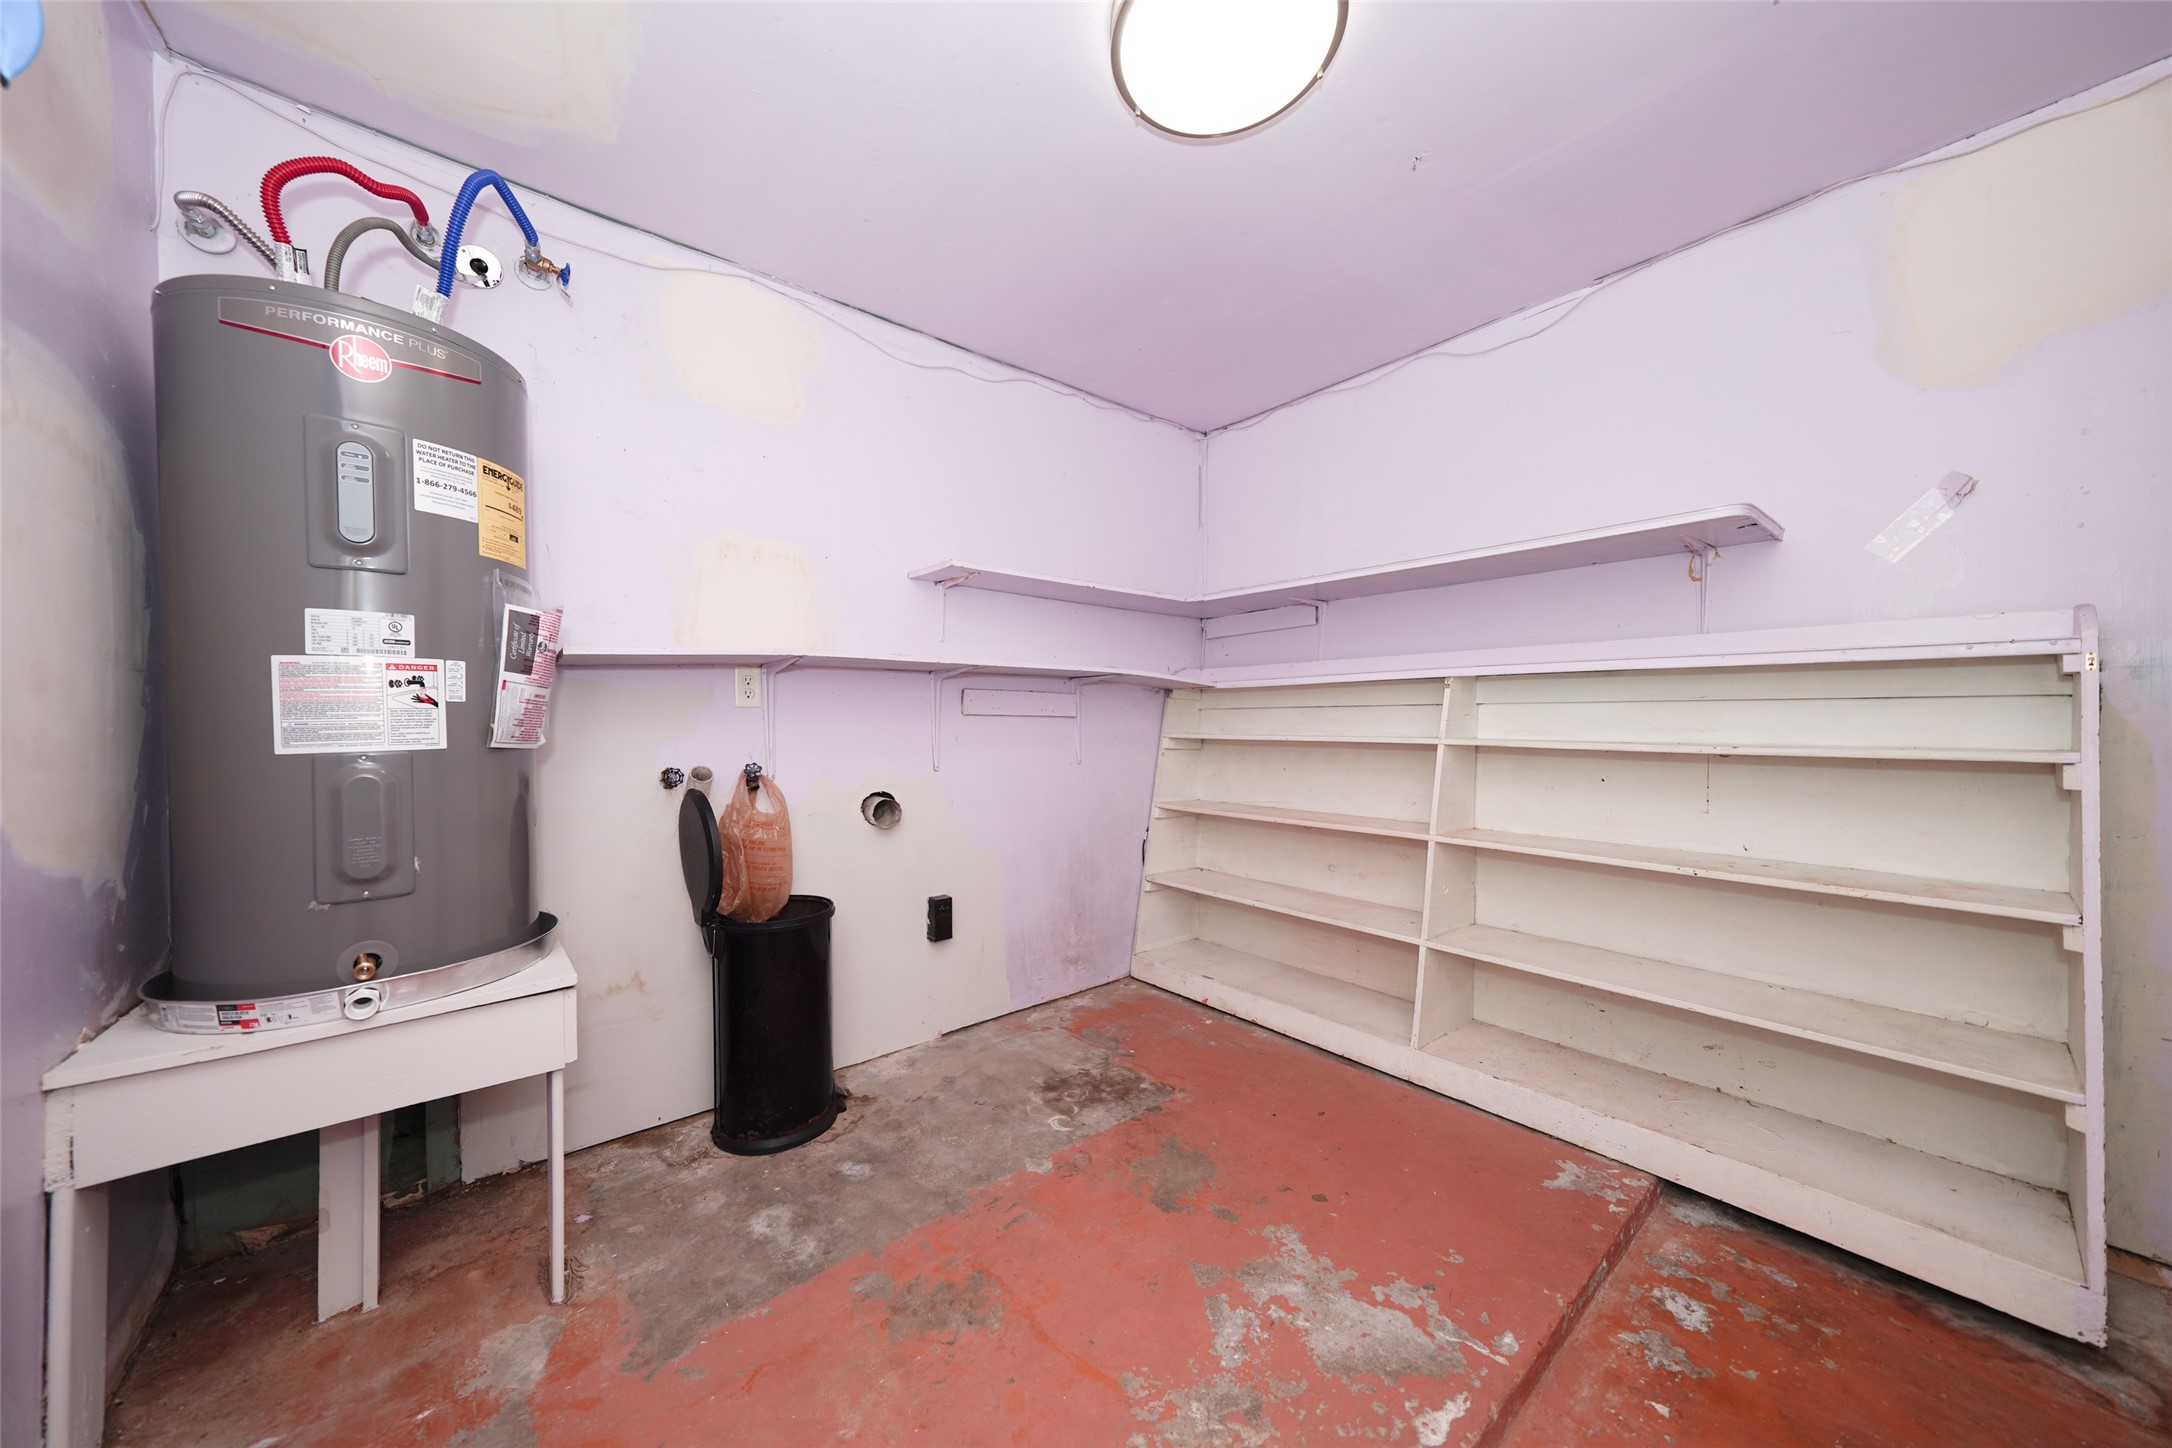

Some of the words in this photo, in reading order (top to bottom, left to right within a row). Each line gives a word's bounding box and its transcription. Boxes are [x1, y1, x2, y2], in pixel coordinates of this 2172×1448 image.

[265, 305, 404, 345] PERFORMANCE
[409, 338, 446, 359] PLUS
[338, 336, 388, 374] Rheem
[416, 450, 436, 458] WATER
[437, 454, 458, 465] HEATER
[428, 445, 440, 453] NOT
[441, 448, 463, 459] RETURN
[464, 455, 475, 463] THIS
[418, 457, 437, 465] PLACE
[447, 464, 475, 476] PURCHASE
[416, 477, 477, 498] 1-866-279-4566
[510, 631, 519, 660] Certificate
[518, 632, 526, 654] Limited
[526, 633, 536, 657] Warranty
